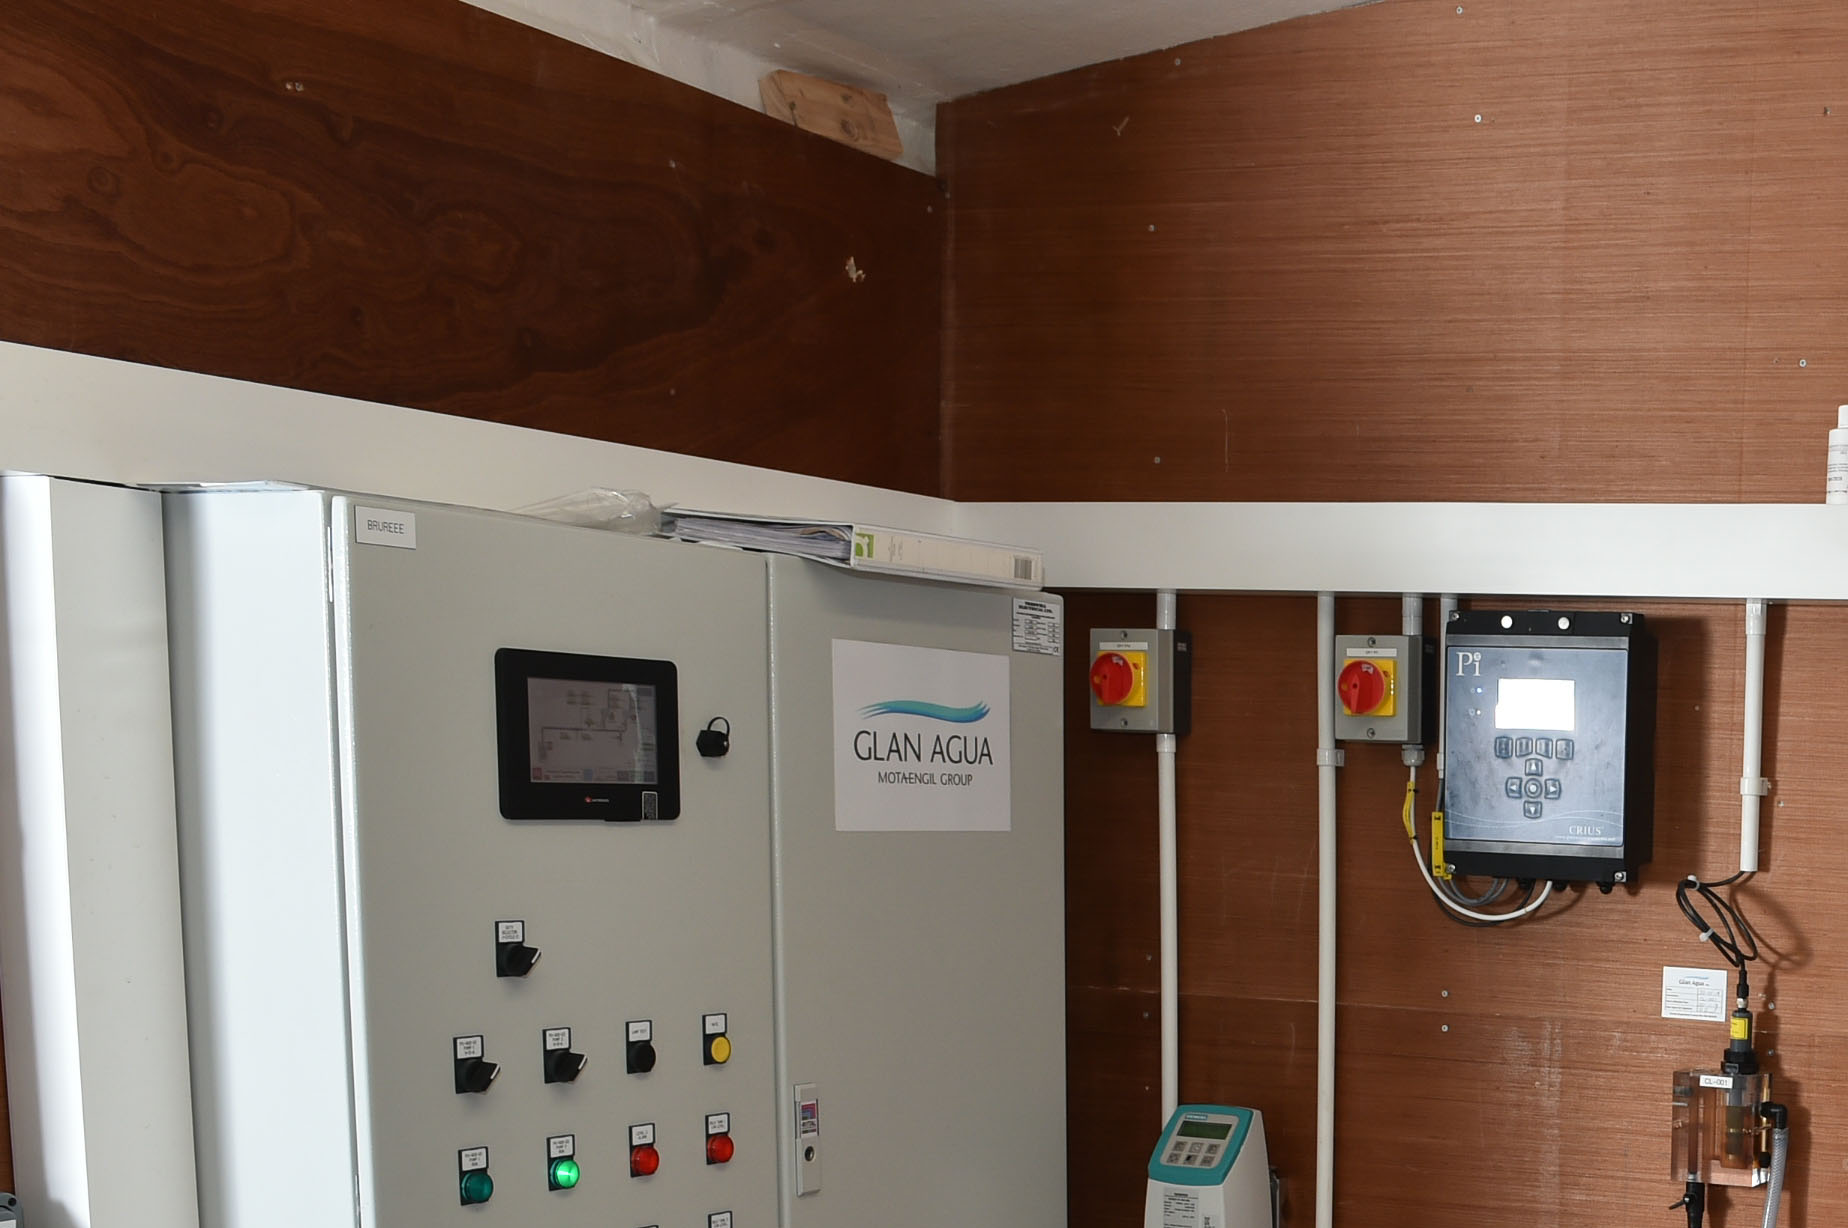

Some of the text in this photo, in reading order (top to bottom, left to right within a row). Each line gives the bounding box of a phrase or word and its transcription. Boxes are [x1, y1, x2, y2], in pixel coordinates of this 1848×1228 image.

[1456, 652, 1482, 677] Pi
[853, 730, 993, 765] GLAN AGUA
[940, 773, 973, 786] GROUP
[1569, 825, 1601, 836] CRIUS
[1704, 1079, 1728, 1087] CL-001
